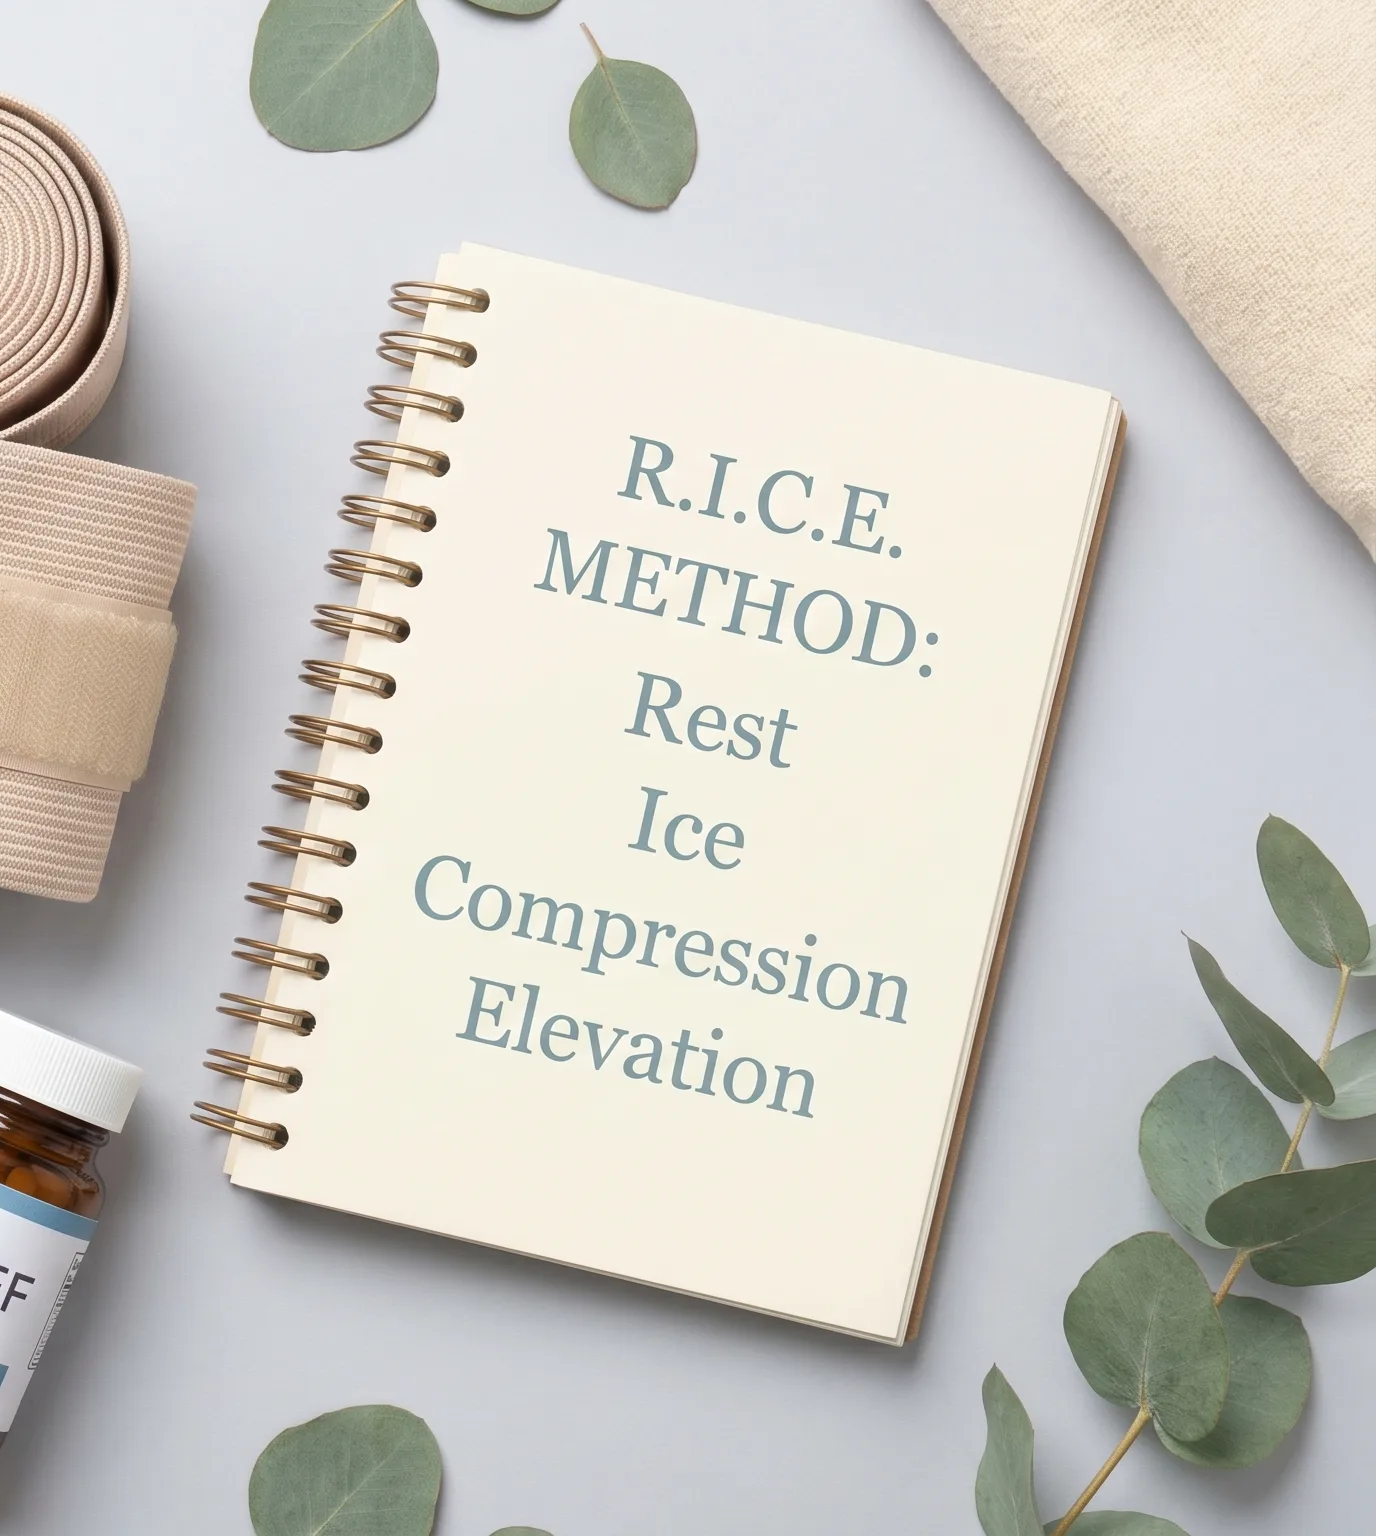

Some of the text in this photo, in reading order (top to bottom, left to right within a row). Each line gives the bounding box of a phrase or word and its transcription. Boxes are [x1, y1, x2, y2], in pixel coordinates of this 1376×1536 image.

[616, 435, 902, 559] R.I.C.E.
[533, 528, 940, 679] METHOD:
[625, 671, 799, 769] Rest
[628, 786, 745, 870] Ice
[413, 854, 909, 1026] Compression
[455, 976, 815, 1119] Elevation
